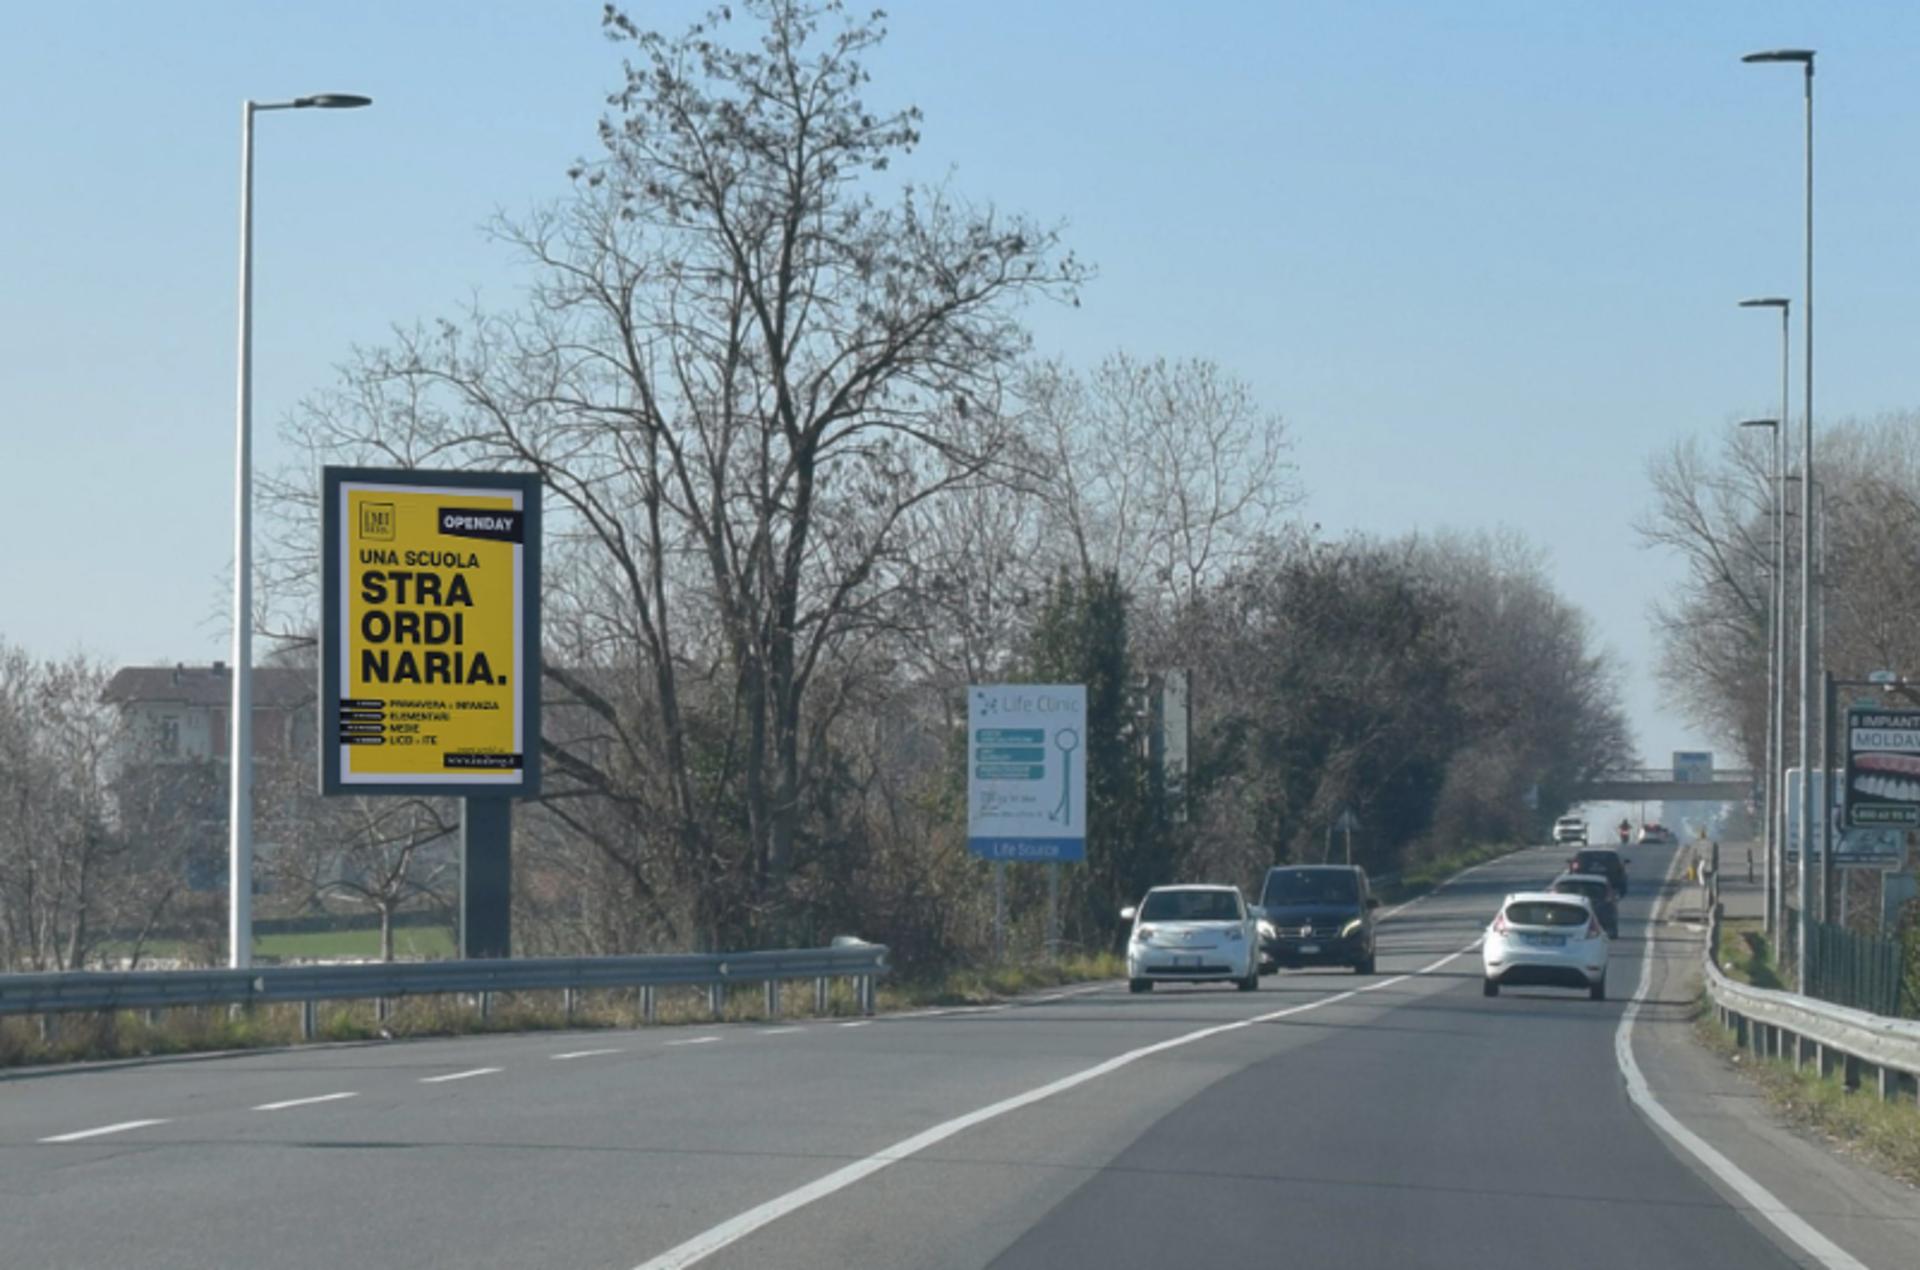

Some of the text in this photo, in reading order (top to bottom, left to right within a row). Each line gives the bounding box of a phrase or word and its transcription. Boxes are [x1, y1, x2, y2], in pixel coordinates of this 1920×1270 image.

[443, 515, 514, 531] OPENDAY
[360, 549, 480, 568] UNA SCUOLA
[361, 570, 474, 606] STRA
[361, 610, 463, 645] ORDI
[361, 649, 507, 685] NARIA.
[1003, 695, 1080, 713] Life Clinic
[390, 724, 419, 733] MEDIE
